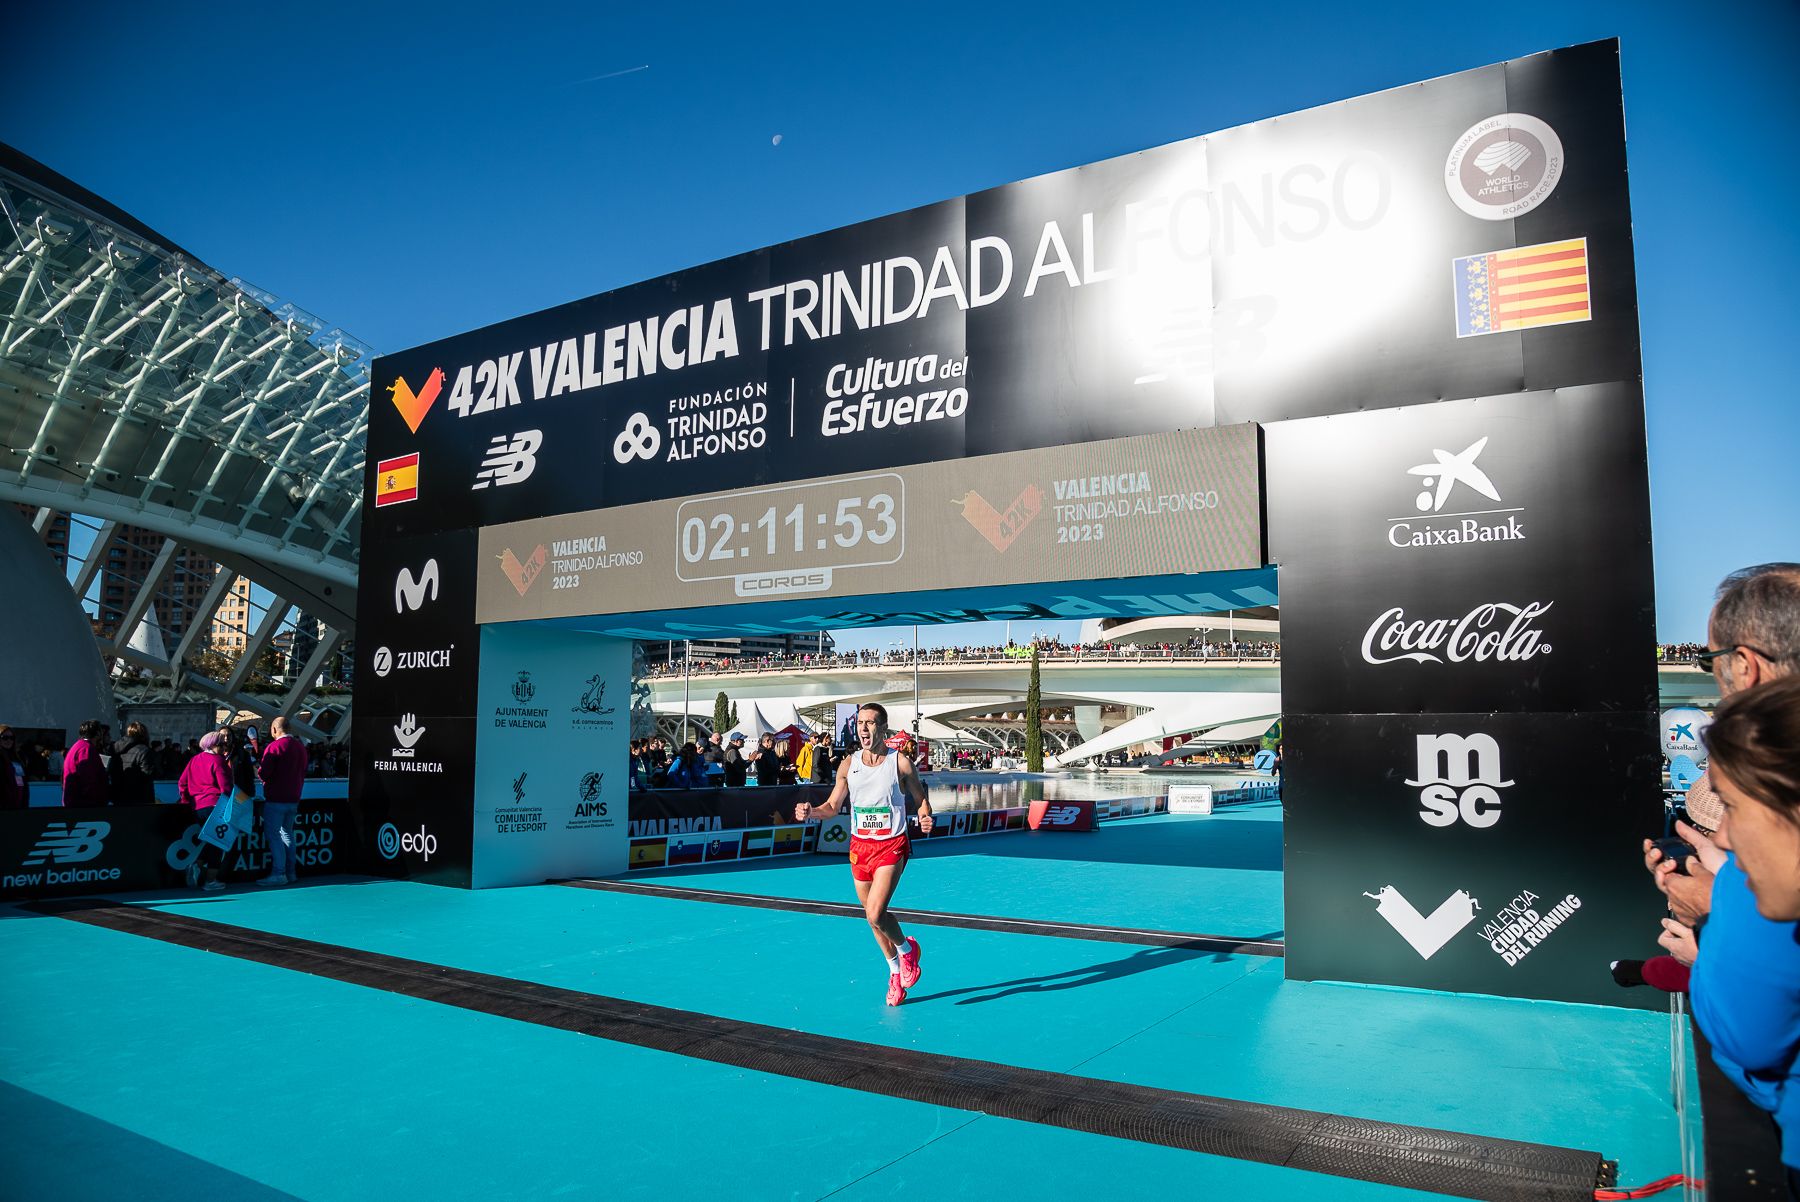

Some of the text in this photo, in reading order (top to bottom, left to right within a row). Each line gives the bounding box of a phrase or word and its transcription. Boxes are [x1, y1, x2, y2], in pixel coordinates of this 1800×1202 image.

[1449, 120, 1502, 177] PLATINUM LABEL
[1478, 181, 1530, 197] ATHLETICS
[1485, 174, 1521, 187] WORLD
[1502, 156, 1558, 216] ROAD RACE 2023
[447, 151, 1392, 418] 42K VALENCIA TRINIDAD ALFONSO
[825, 354, 969, 399] Cultura del
[669, 381, 767, 413] FUNDACIÓN
[667, 402, 768, 439] TRINIDAD
[821, 387, 969, 437] Esfuerzo
[666, 426, 767, 463] ALFONSO
[1053, 471, 1152, 500] VALENCIA
[1053, 490, 1220, 523] TRINIDAD ALFONSO
[682, 493, 898, 563] 02:11:53
[1057, 523, 1105, 544] 2023
[1388, 515, 1526, 548] CaixaBank
[552, 535, 607, 557] VALENCIA
[551, 550, 644, 575] TRINIDAD ALFONSO
[552, 575, 580, 590] 2023
[742, 574, 824, 591] COROS
[495, 707, 549, 718] AJUNTAMENT
[495, 719, 506, 728] DE
[374, 761, 443, 773] FERIA VALENCIA
[495, 813, 543, 824] COMUNITAT
[574, 802, 608, 818] AIMS
[498, 822, 548, 834] DE L'ESPORT
[862, 821, 883, 829] DARIO
[401, 824, 437, 861] edp
[233, 847, 333, 872] ALFNSO
[2, 866, 121, 888] new balance
[1477, 889, 1540, 942] VALENCIA
[1490, 909, 1540, 954] CIUDAD
[1501, 894, 1582, 967] DEL RUNNING
